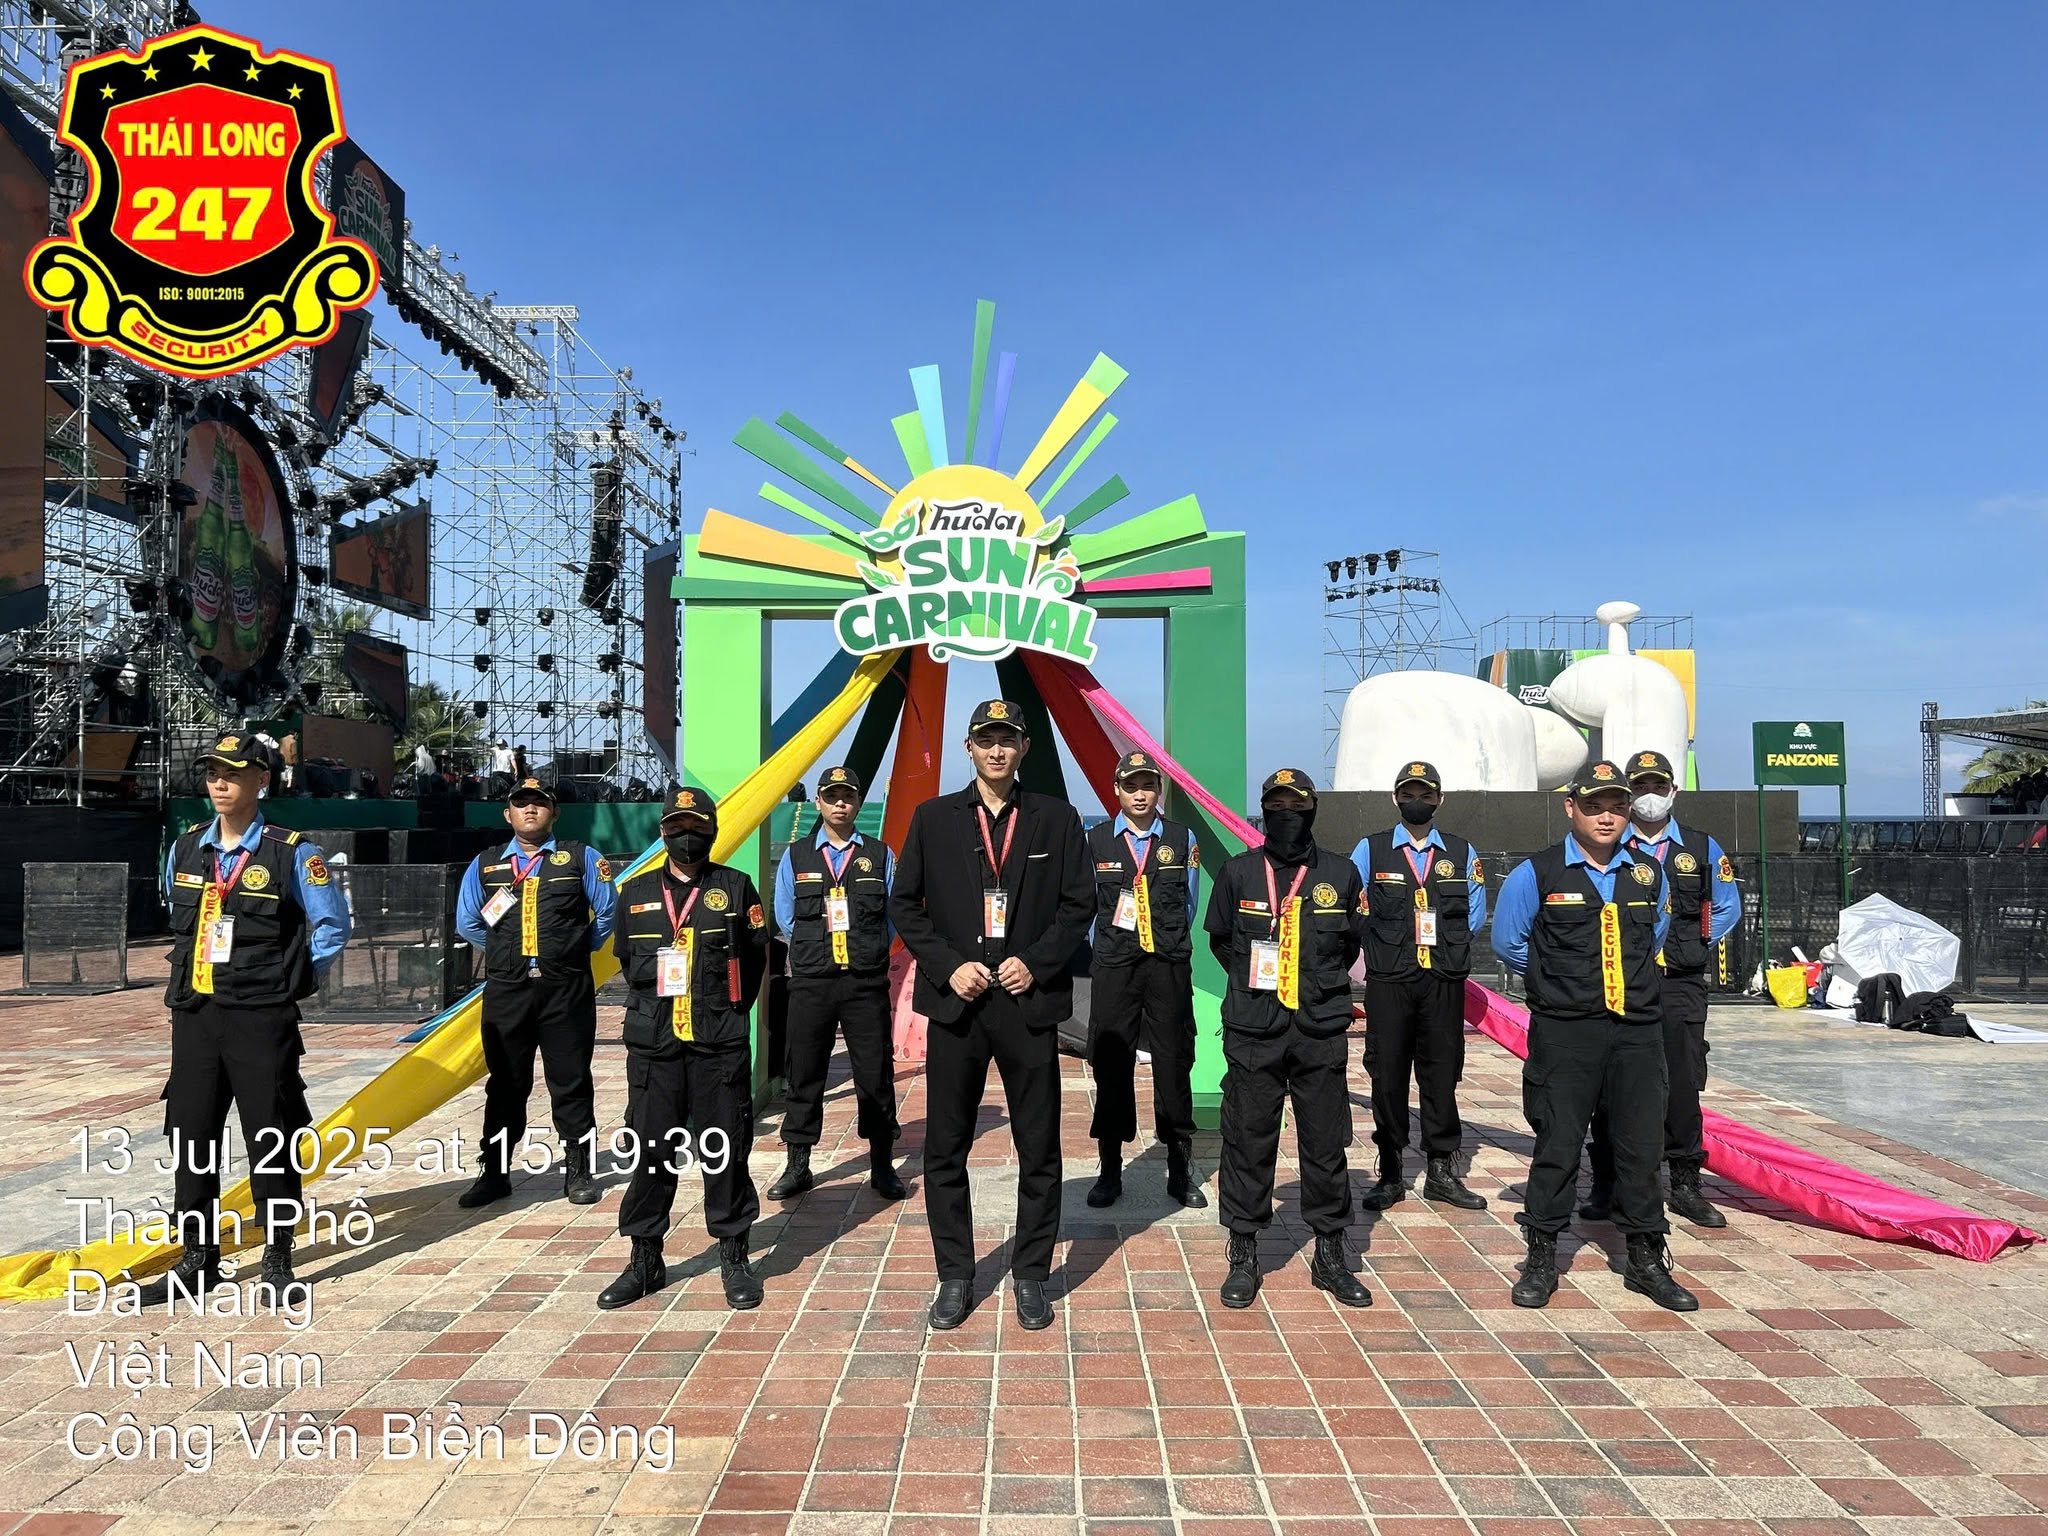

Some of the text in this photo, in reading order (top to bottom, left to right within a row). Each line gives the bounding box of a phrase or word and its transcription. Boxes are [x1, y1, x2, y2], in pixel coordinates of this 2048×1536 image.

[930, 501, 1017, 531] huda
[904, 537, 1031, 588] SUN
[839, 591, 1095, 661] CARNIVAL
[1520, 686, 1547, 699] hud
[1766, 754, 1839, 766] FANZONE
[524, 877, 535, 956] SECURITY
[1603, 909, 1618, 1010] SECURITY
